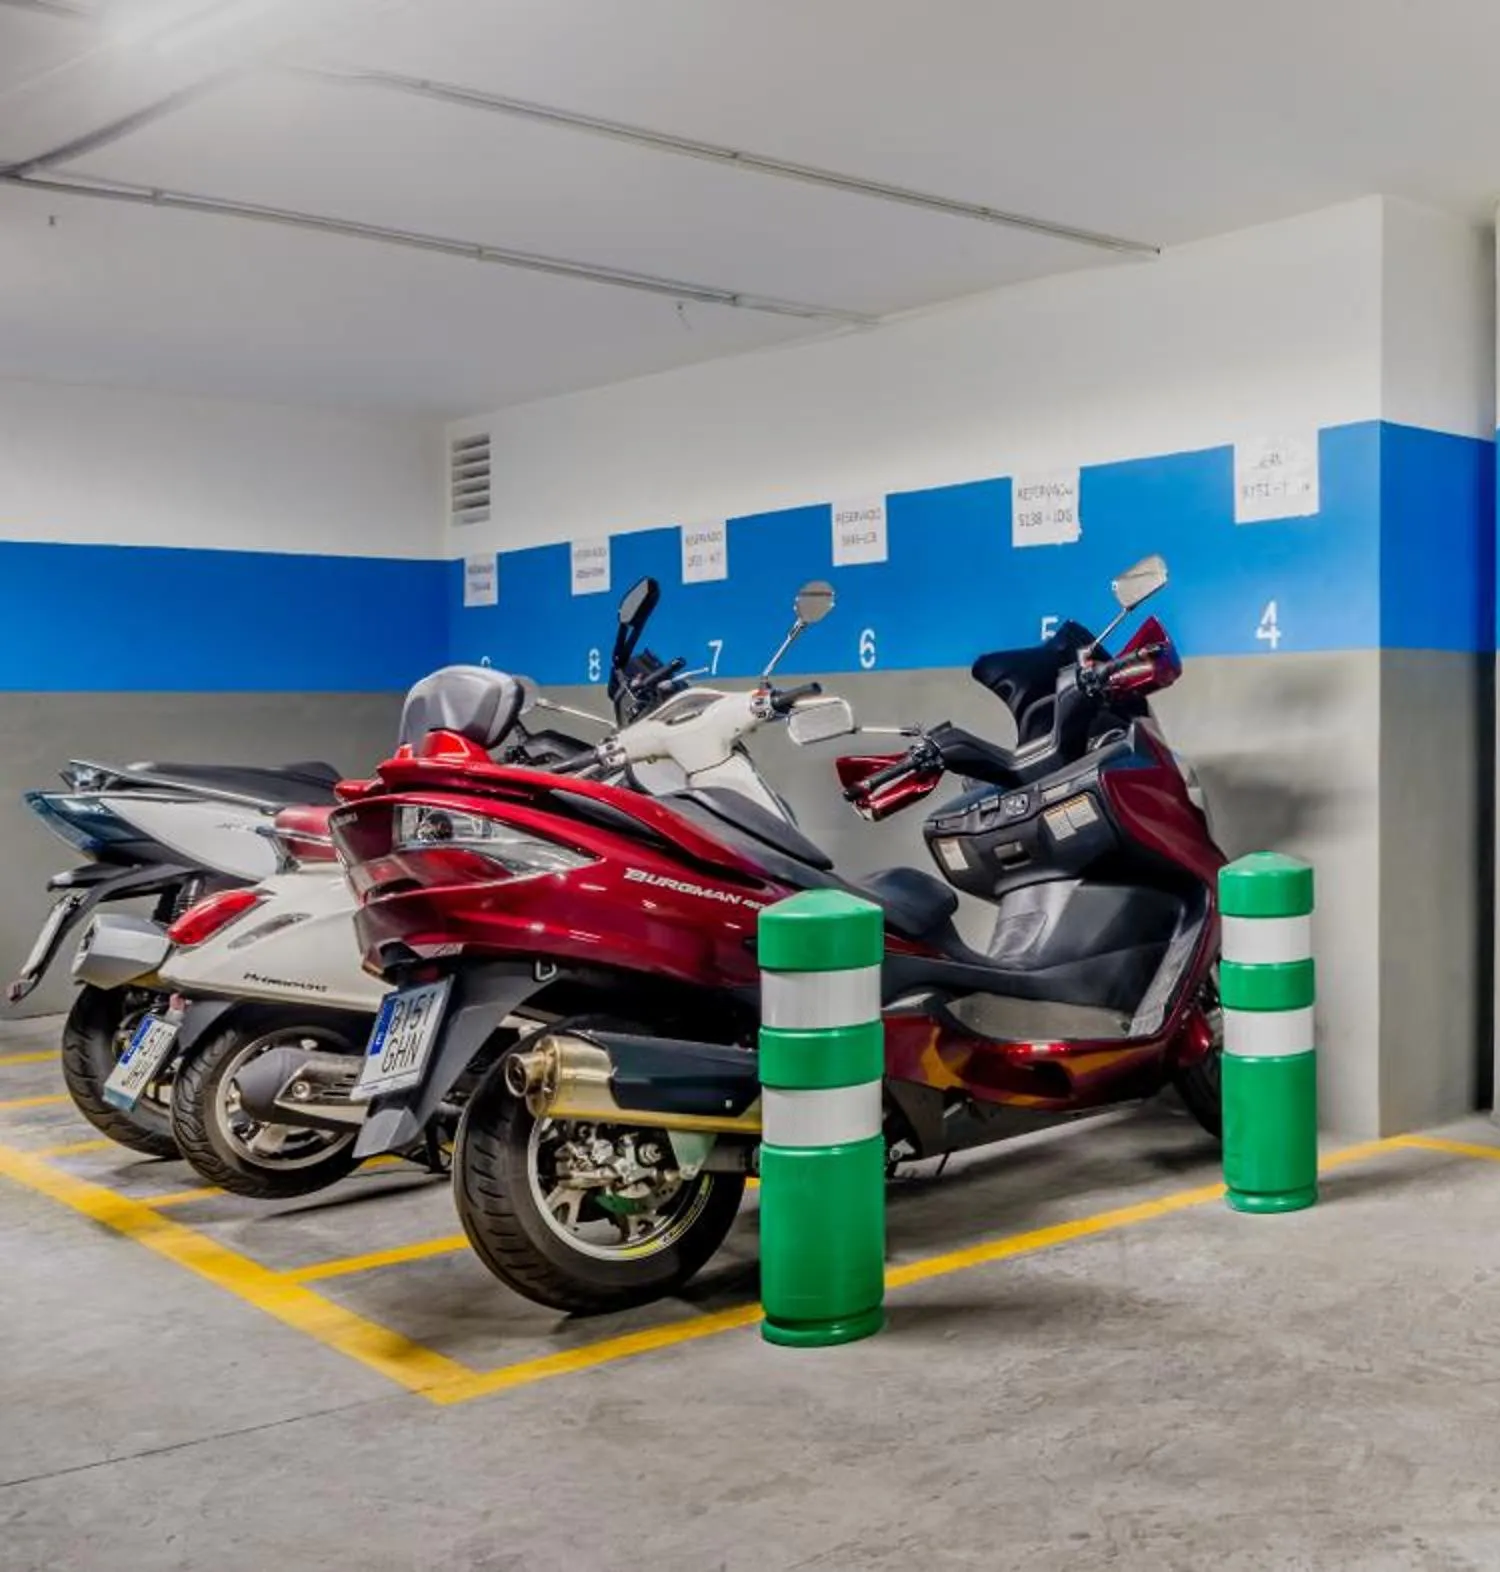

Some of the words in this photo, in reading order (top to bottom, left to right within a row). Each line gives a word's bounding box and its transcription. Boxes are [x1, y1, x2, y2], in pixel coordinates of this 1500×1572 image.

[1255, 600, 1281, 649] 4
[588, 648, 600, 681] 8
[708, 640, 722, 675] 7
[859, 628, 876, 669] 6
[623, 867, 741, 904] BURGMAN
[390, 991, 436, 1034] 8151
[381, 1030, 424, 1073] GHN
